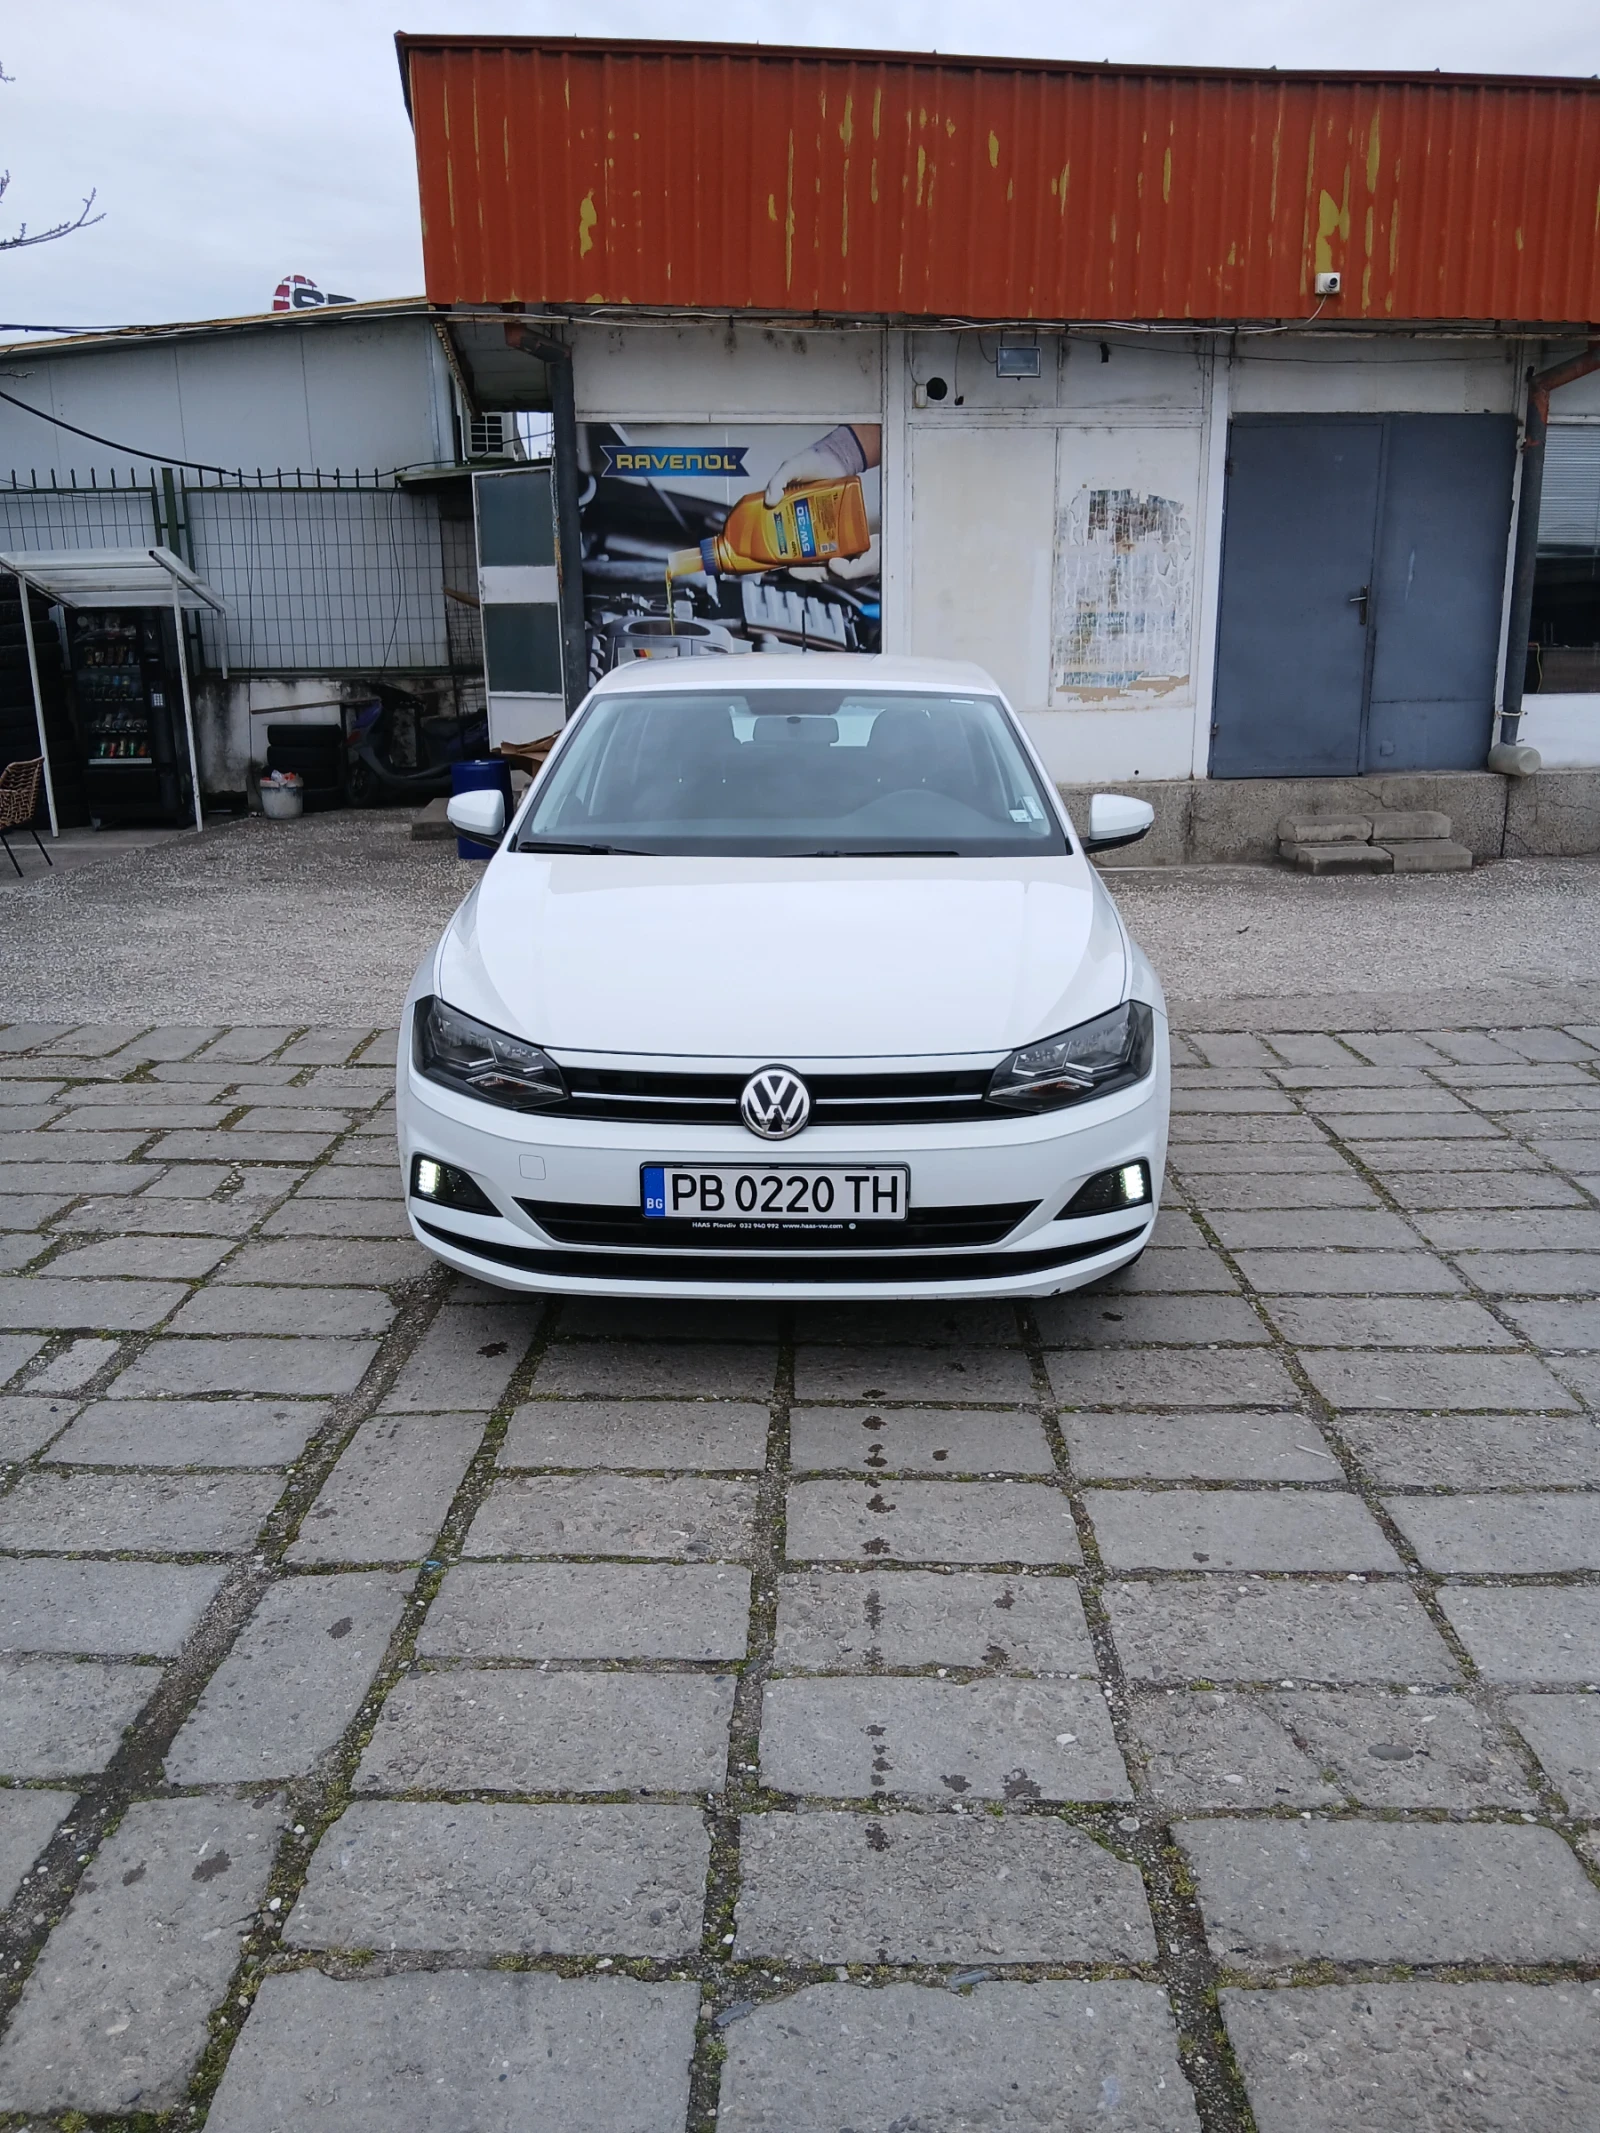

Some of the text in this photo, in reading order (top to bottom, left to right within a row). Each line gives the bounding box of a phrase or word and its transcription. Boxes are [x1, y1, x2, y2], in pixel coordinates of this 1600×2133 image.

[616, 454, 737, 470] RAVENOL
[796, 506, 810, 552] 5W-30
[646, 1198, 664, 1210] BG
[671, 1173, 898, 1214] PB 0220 TH
